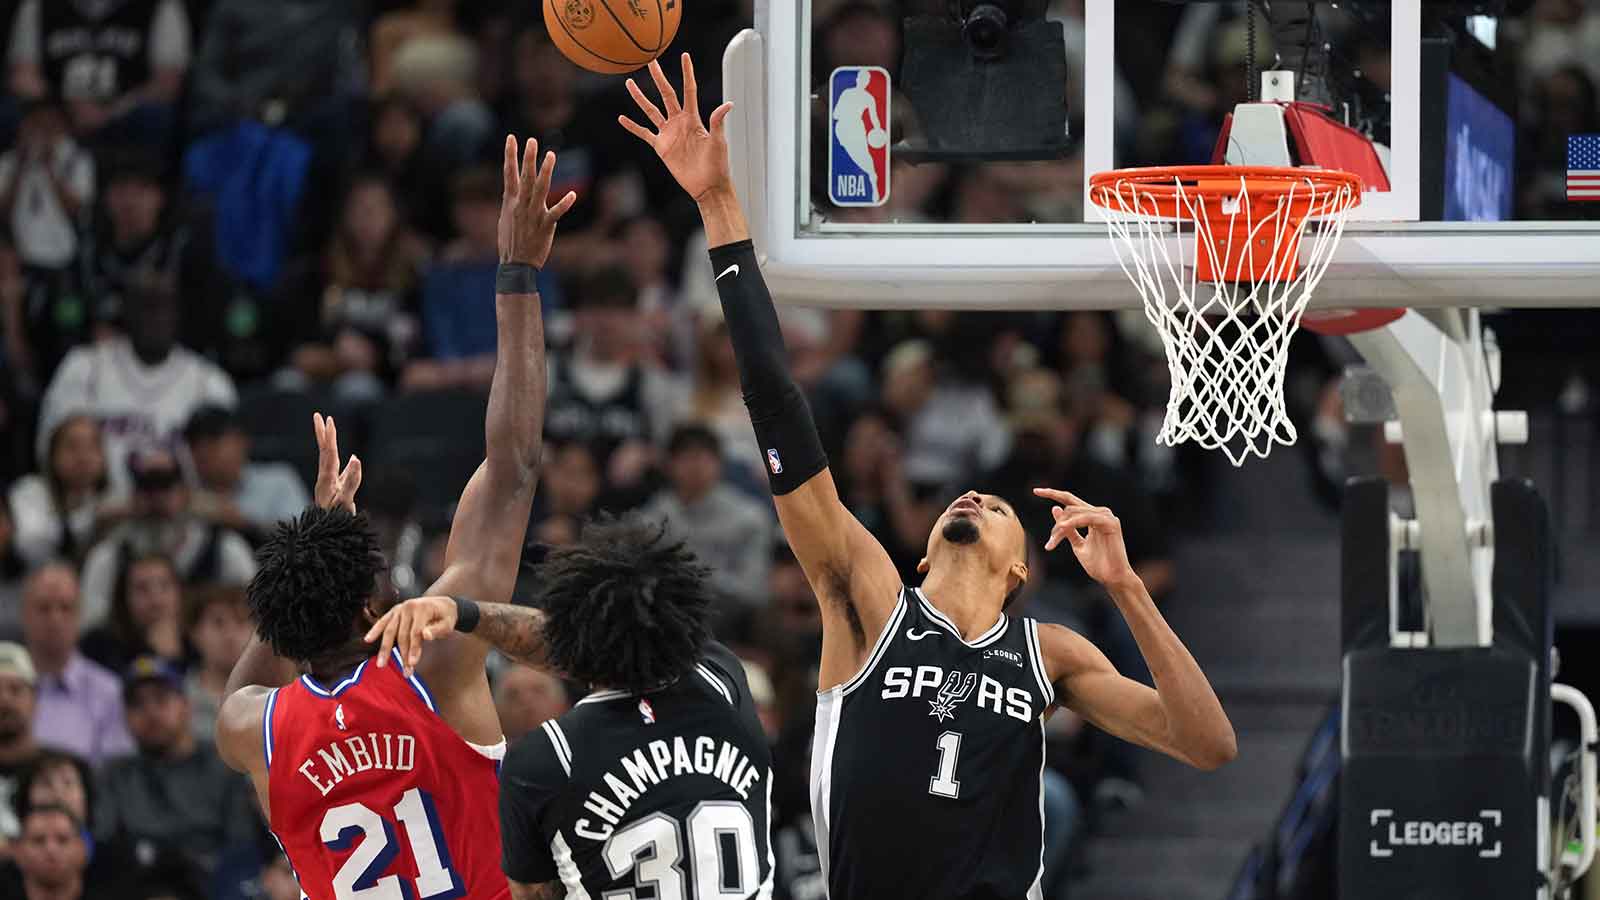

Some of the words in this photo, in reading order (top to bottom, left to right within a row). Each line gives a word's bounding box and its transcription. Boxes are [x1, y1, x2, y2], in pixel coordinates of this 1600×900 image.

[838, 174, 866, 197] NBA
[988, 650, 1018, 662] LEDGER
[881, 665, 1033, 723] SPURS
[298, 733, 415, 797] EMBIID
[574, 736, 760, 841] CHAMPAGNIE
[928, 730, 962, 799] 1
[319, 787, 464, 900] 21
[601, 800, 760, 900] 30
[1388, 821, 1483, 845] LEDGER
